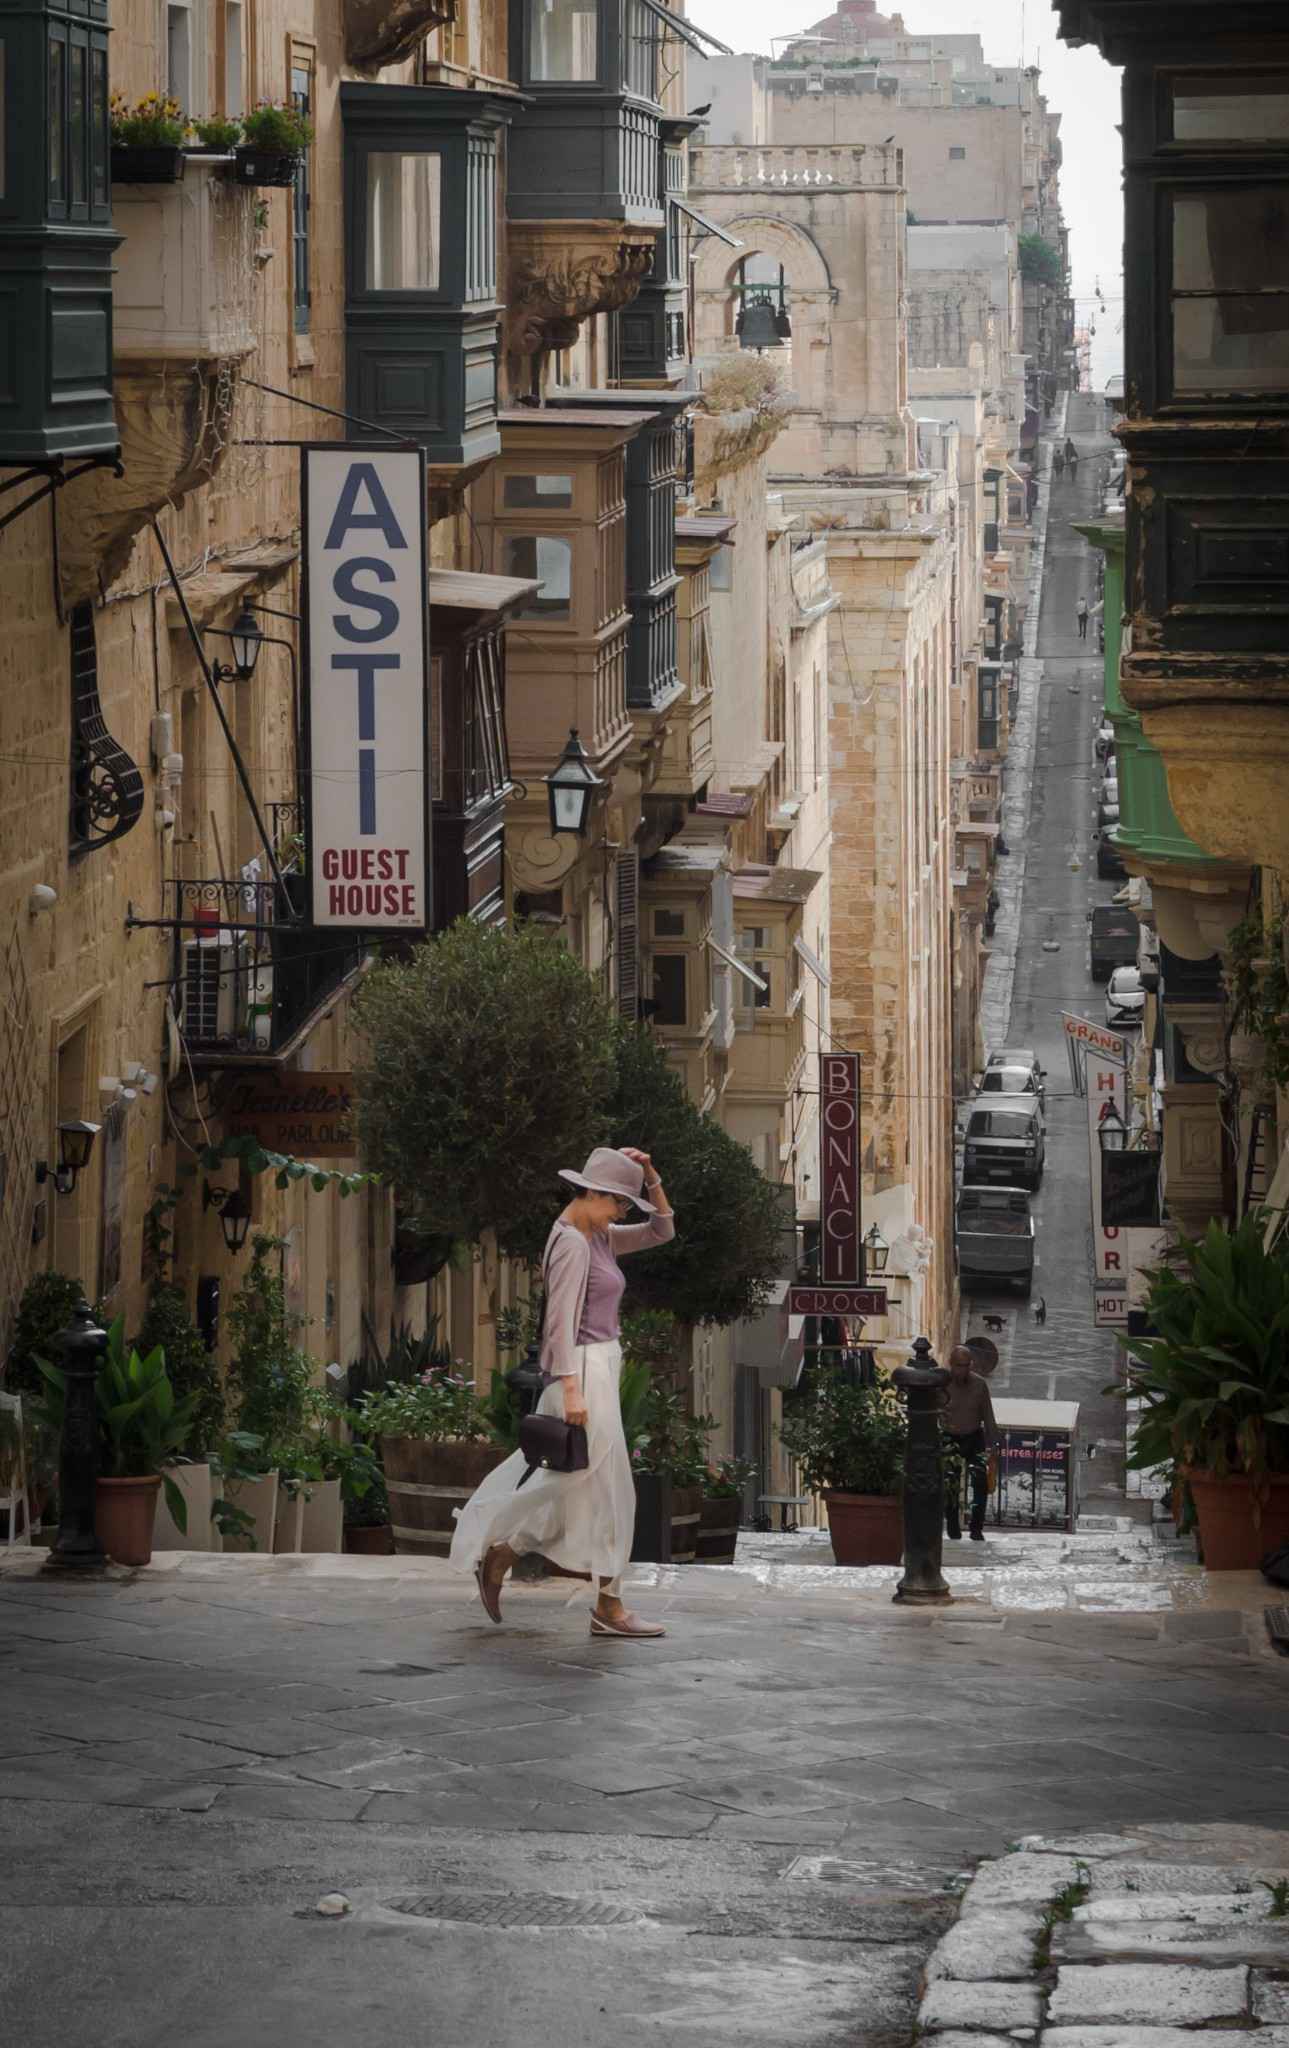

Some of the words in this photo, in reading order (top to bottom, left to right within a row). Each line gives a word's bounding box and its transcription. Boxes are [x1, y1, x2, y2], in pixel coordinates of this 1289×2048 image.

[323, 462, 409, 836] ASTI
[322, 849, 410, 881] GUEST
[328, 884, 416, 917] HOUSE
[1065, 1020, 1123, 1054] GRAND
[825, 1060, 855, 1276] BONACI
[1097, 1299, 1126, 1313] HOT
